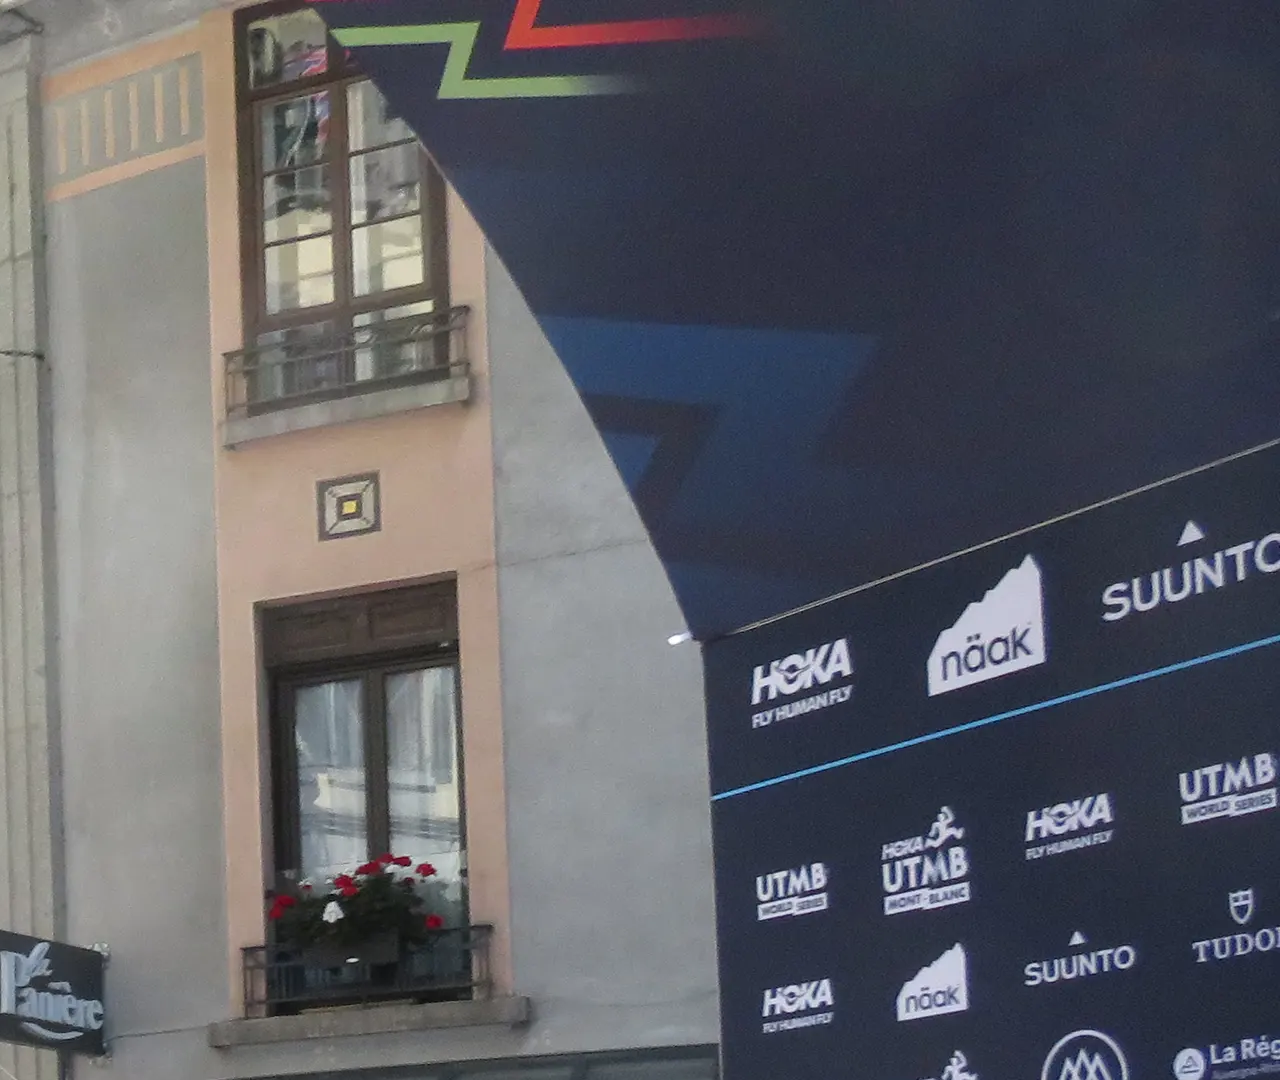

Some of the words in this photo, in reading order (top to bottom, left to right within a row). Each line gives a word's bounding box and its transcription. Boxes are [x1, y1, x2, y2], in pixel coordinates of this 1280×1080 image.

[1102, 532, 1280, 622] SUUNTO
[751, 638, 854, 705] HOKA
[942, 625, 1032, 682] näak
[752, 710, 774, 729] FLY
[776, 691, 828, 722] HUMAN
[828, 684, 854, 704] FLY
[1178, 752, 1276, 802] UTMB
[1024, 793, 1115, 841] HOKA
[881, 846, 968, 893] UTMB
[882, 836, 924, 860] HOKA
[756, 862, 828, 902] UTMB
[1024, 945, 1137, 986] SUUNTO
[762, 978, 835, 1017] HOKA
[905, 983, 961, 1013] näak
[1210, 1043, 1236, 1065] La
